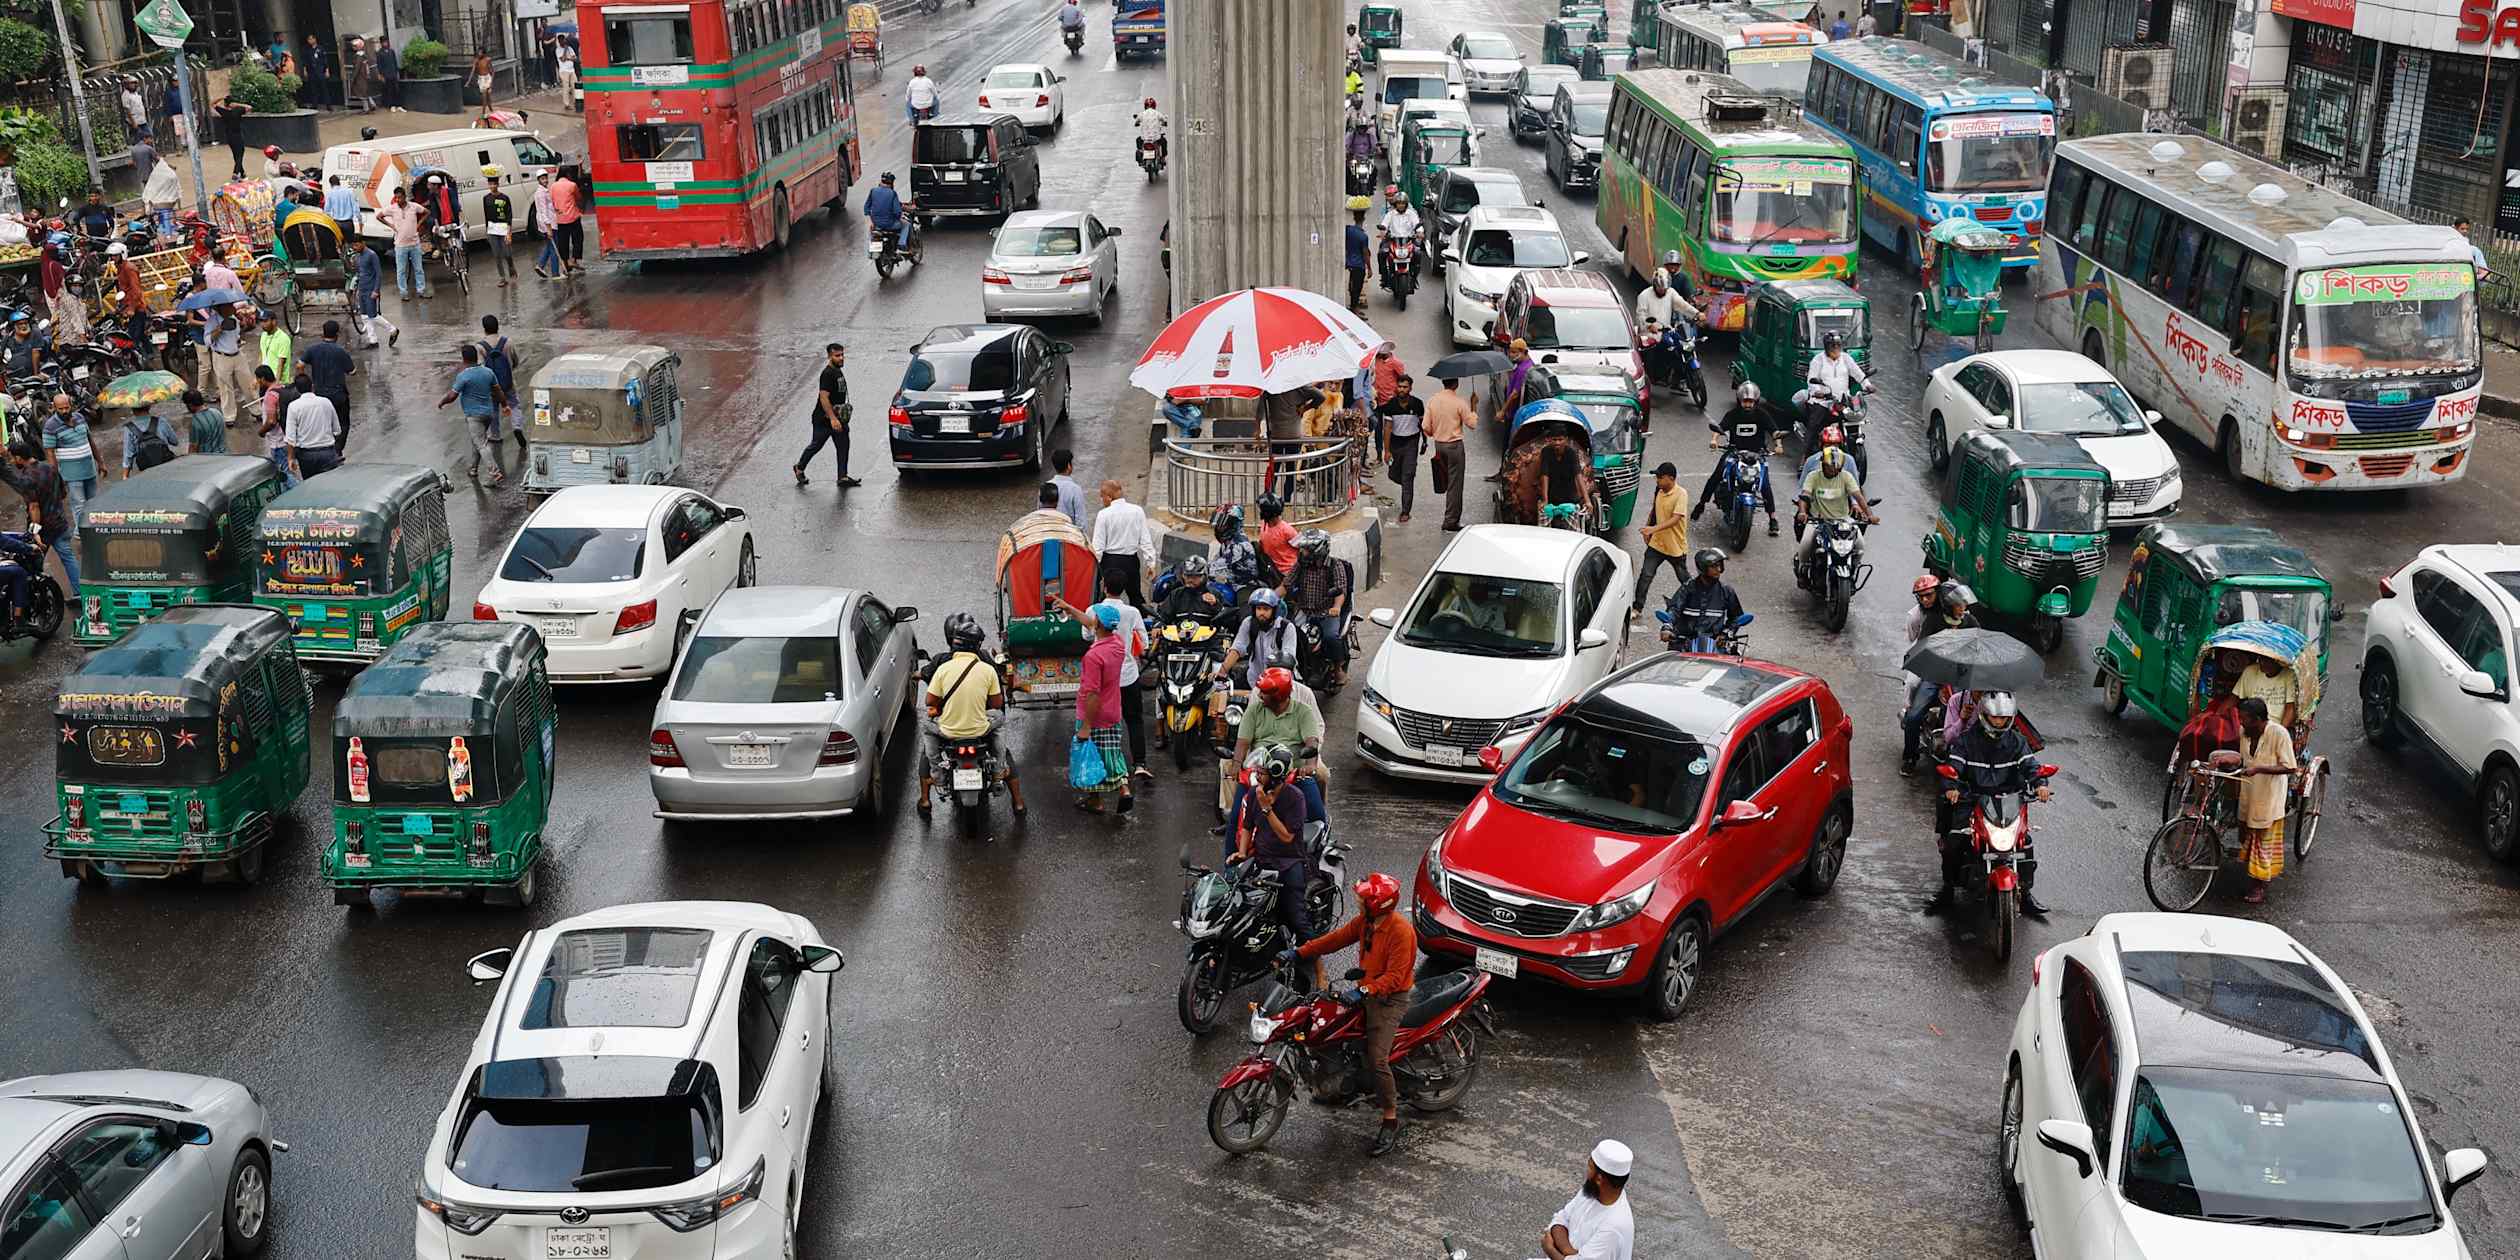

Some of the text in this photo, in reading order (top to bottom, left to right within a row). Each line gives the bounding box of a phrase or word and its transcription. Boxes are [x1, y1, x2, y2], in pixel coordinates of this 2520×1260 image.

[2456, 0, 2520, 48] SA
[2322, 269, 2411, 299] শিকড়
[2165, 311, 2208, 383] শিকড়
[2292, 400, 2344, 431] শিকড়
[2437, 395, 2479, 423] শিকড়
[1495, 910, 1512, 920] KIA
[549, 1245, 609, 1257] ১৮-০২৬৪
[551, 1234, 569, 1242] ঢাকা
